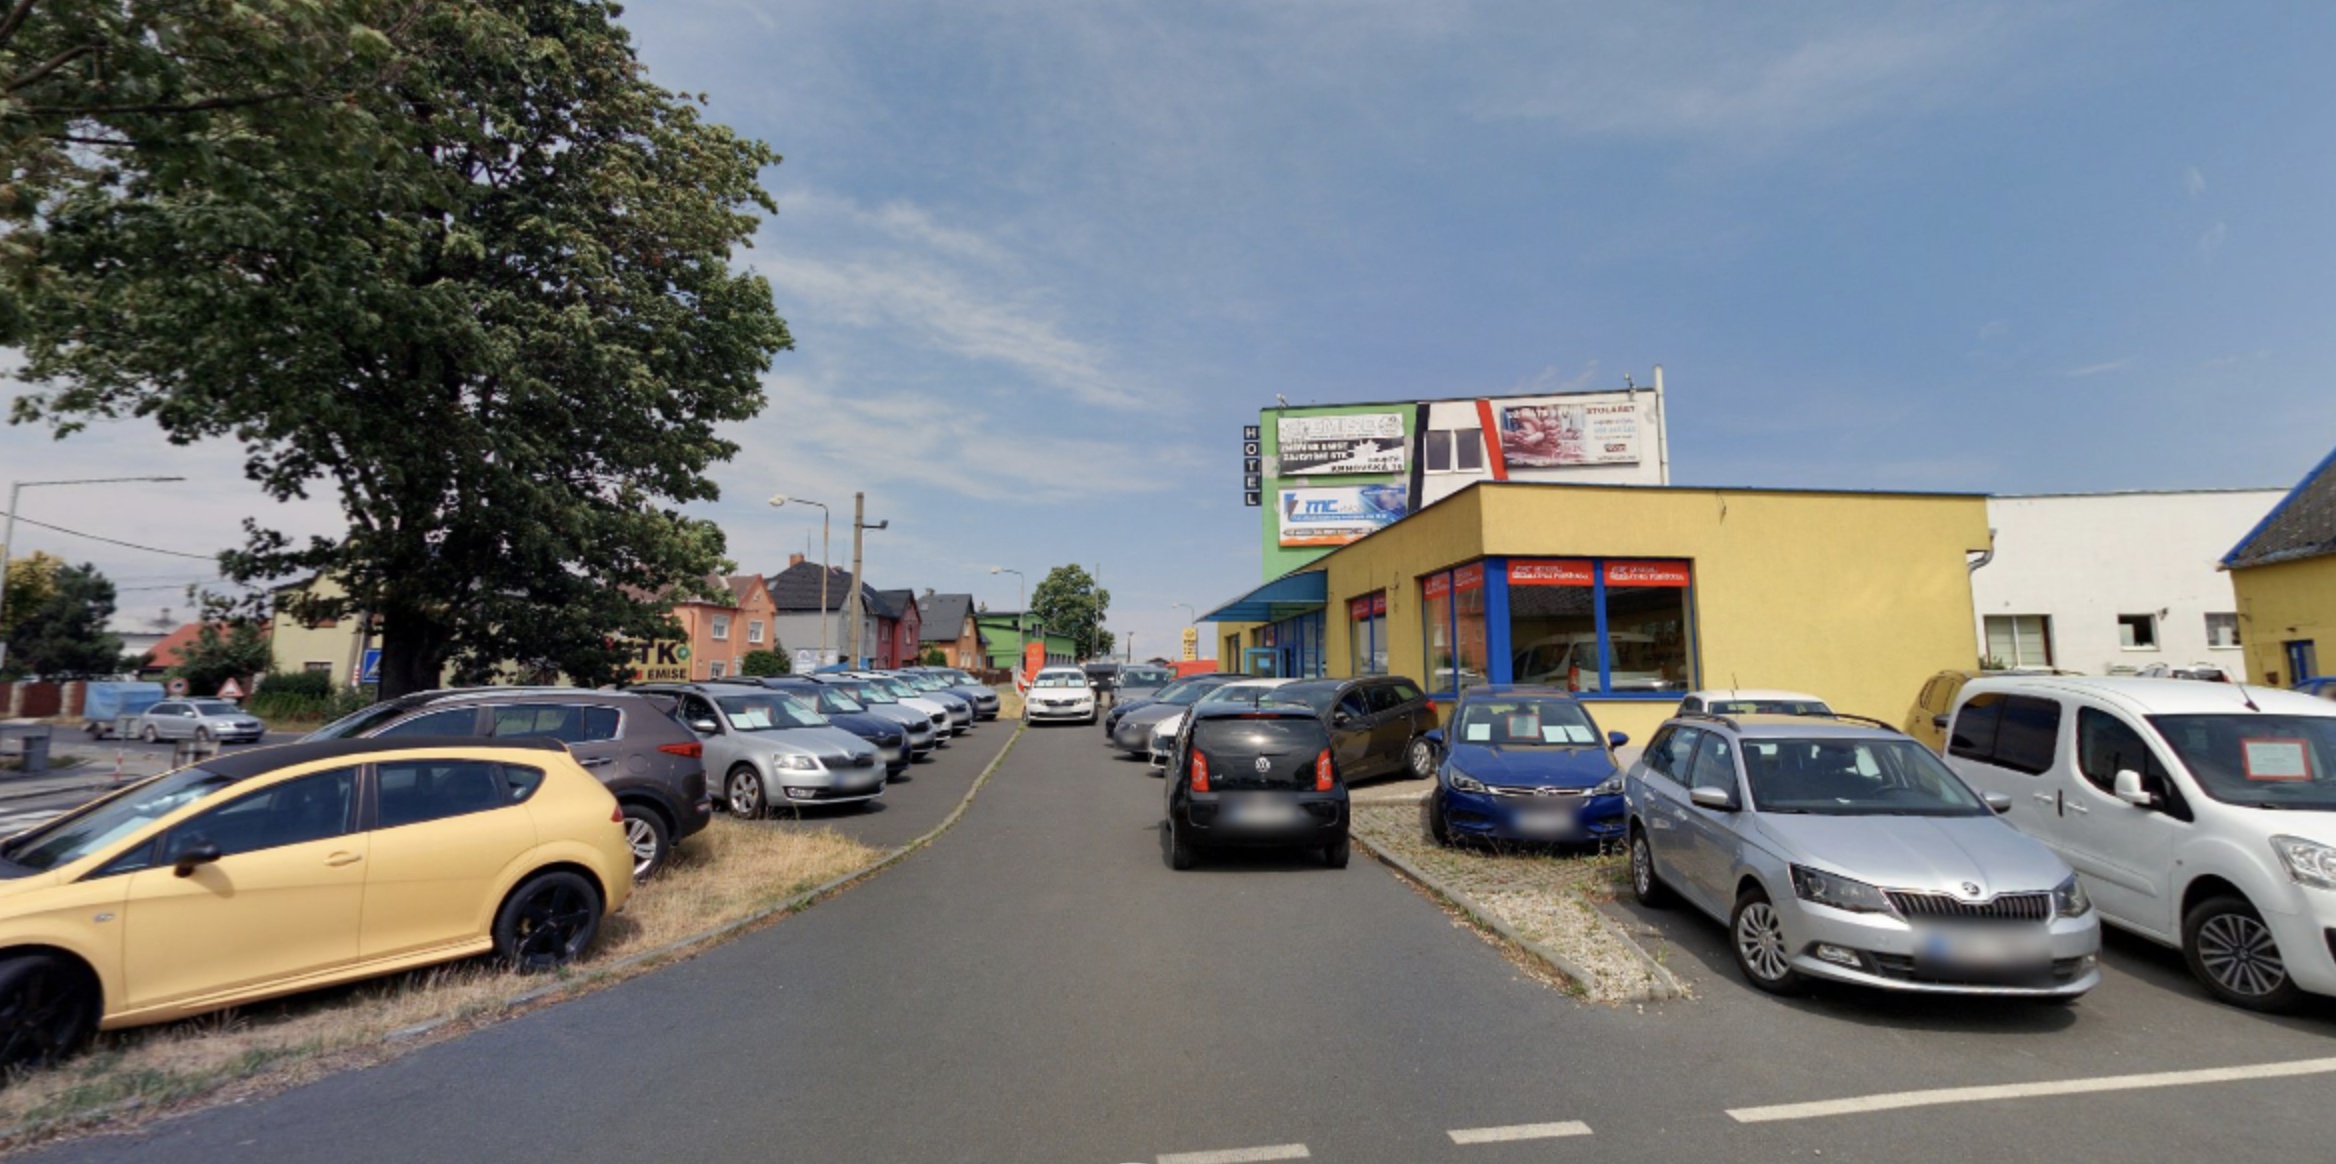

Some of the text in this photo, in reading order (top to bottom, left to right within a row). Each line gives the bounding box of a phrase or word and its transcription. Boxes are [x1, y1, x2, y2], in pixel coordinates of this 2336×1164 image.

[1245, 427, 1258, 505] HOTEL
[630, 641, 679, 665] TK
[648, 668, 687, 681] EMISE
